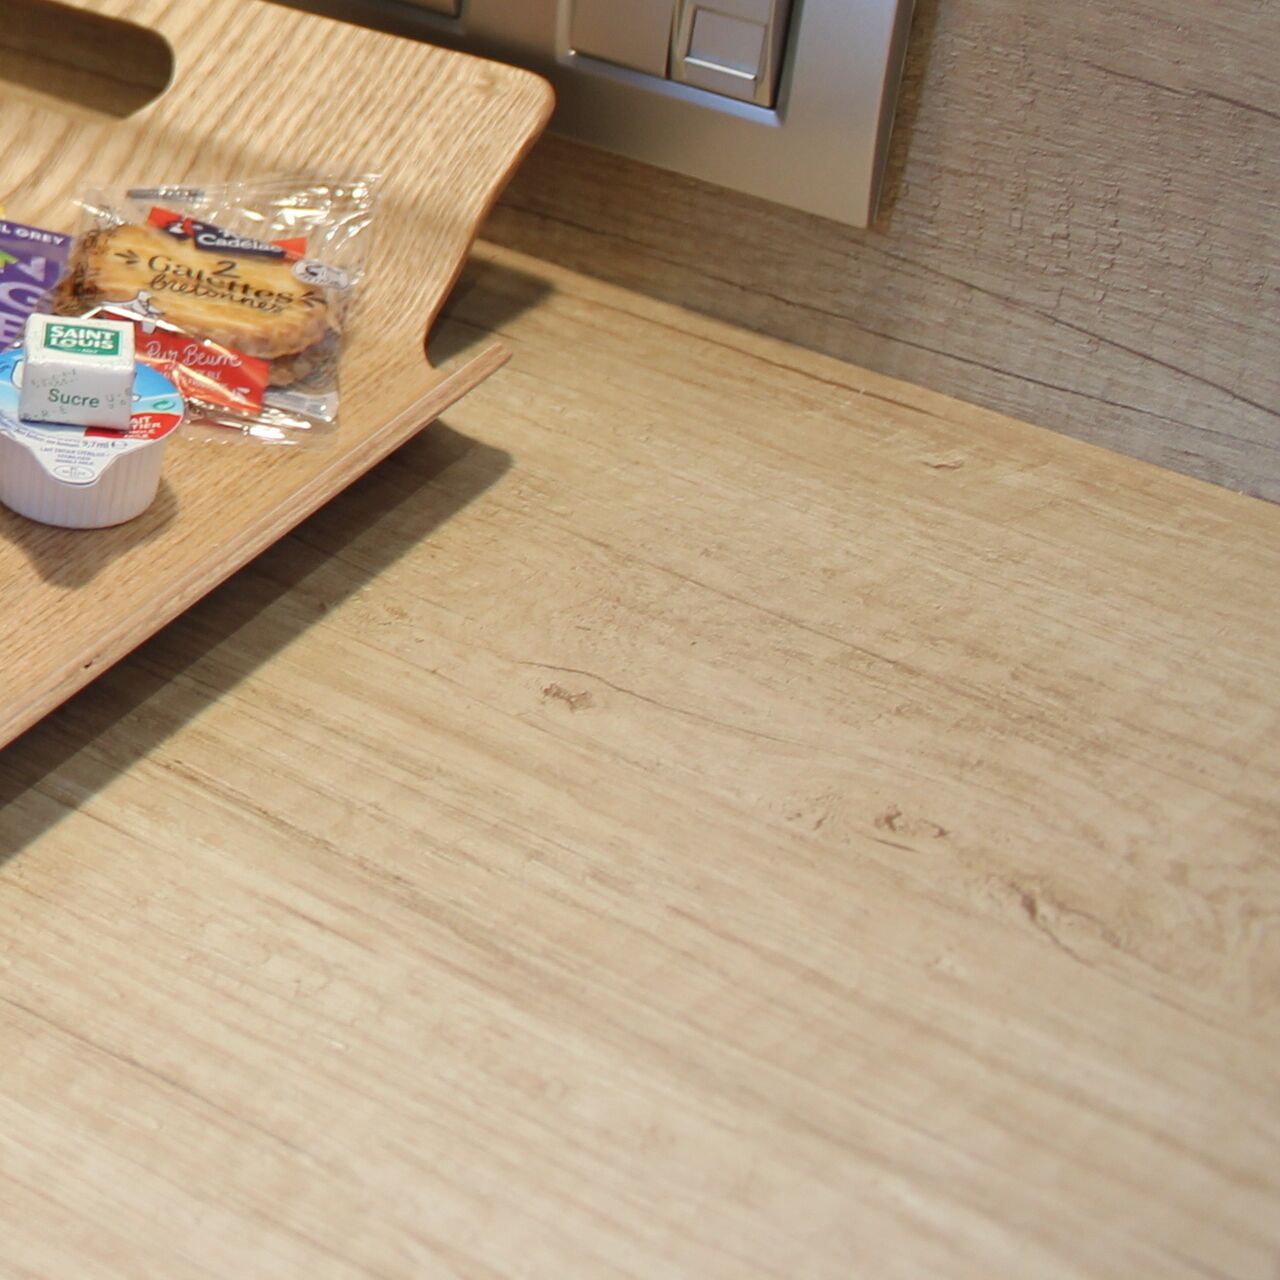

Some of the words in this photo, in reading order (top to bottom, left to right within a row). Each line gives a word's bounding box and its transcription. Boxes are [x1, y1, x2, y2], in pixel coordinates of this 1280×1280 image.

[15, 228, 66, 246] GREY
[213, 260, 240, 279] 2
[50, 325, 115, 340] SAINT
[49, 337, 114, 350] LOUIS
[47, 388, 100, 408] Sucre
